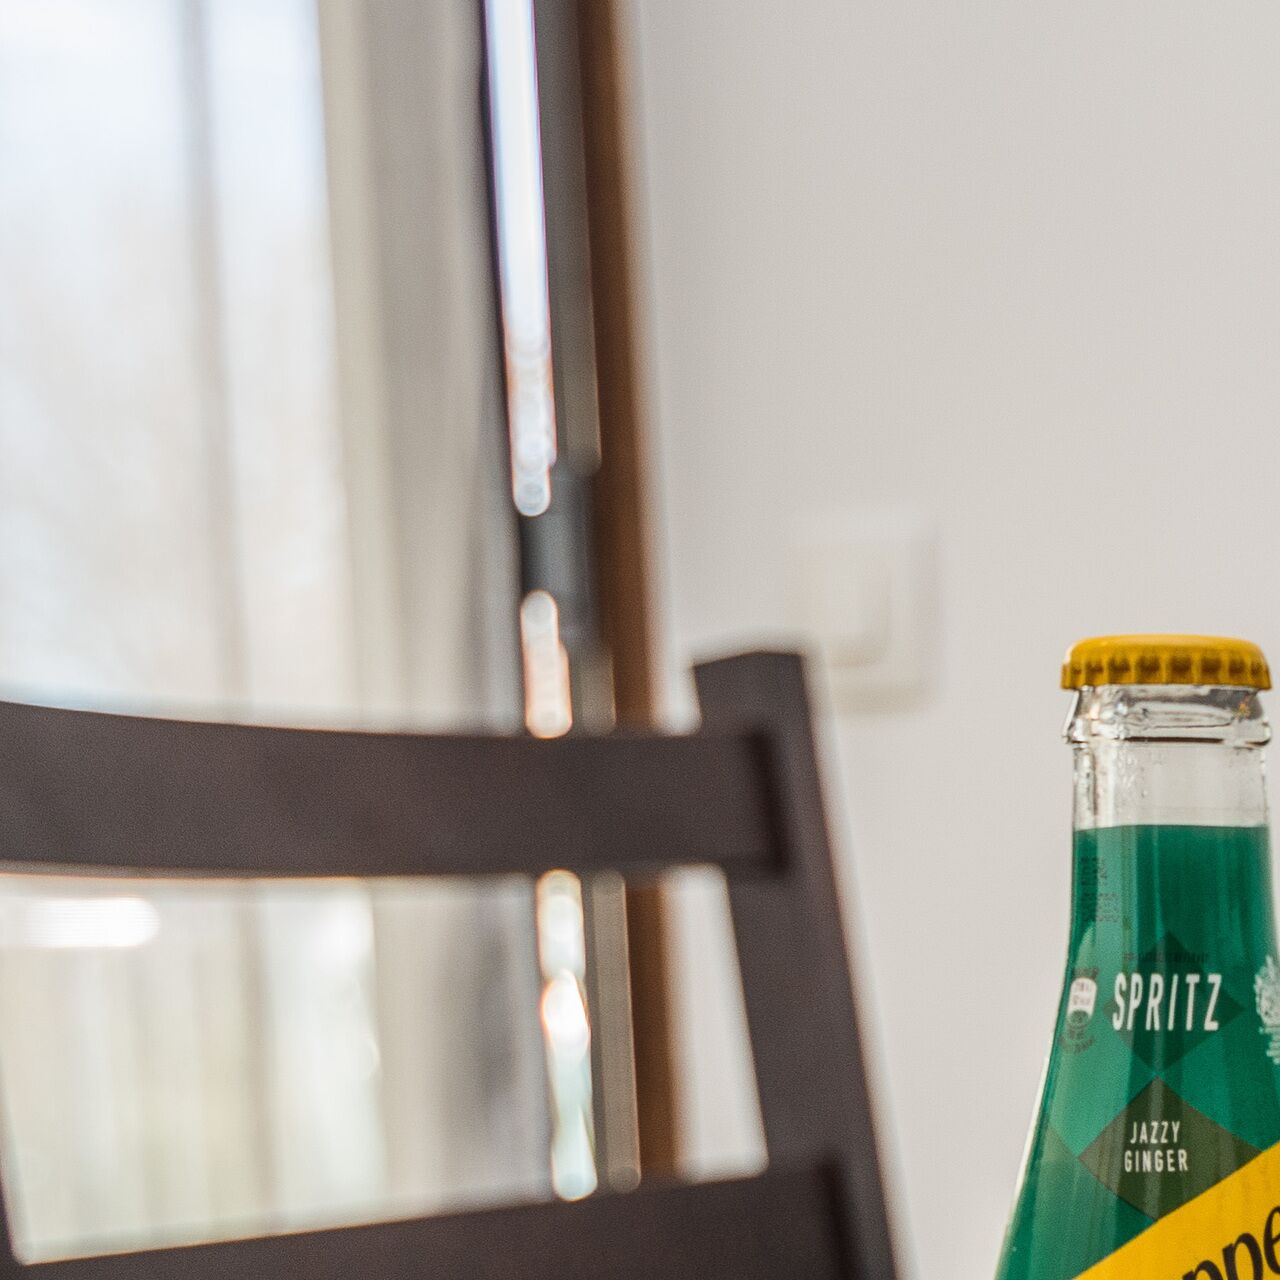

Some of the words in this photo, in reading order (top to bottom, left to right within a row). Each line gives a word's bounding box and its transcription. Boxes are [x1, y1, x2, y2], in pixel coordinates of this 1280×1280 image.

[1111, 971, 1223, 1032] SPRITZ
[1129, 1121, 1181, 1145] JAZZY
[1123, 1149, 1189, 1173] GINGER
